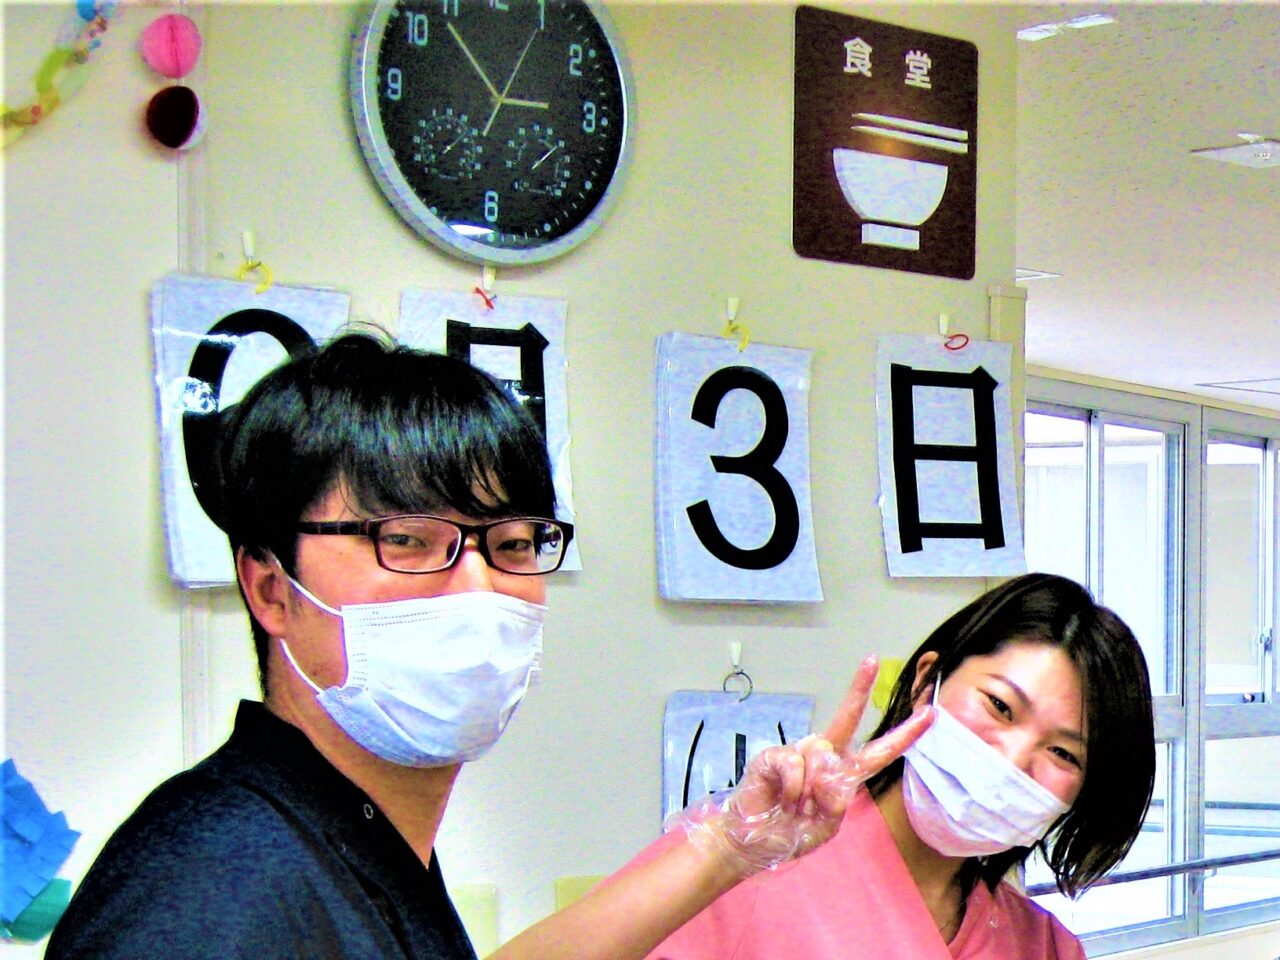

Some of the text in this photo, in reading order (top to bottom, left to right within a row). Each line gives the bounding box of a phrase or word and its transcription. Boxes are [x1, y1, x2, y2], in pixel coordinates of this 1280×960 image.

[405, 11, 429, 47] 10
[569, 43, 583, 77] 2
[843, 36, 932, 90] 食堂
[387, 67, 402, 101] 9
[582, 101, 597, 133] 3
[484, 190, 499, 222] 6
[686, 365, 800, 571] 3
[890, 362, 1006, 554] 日
